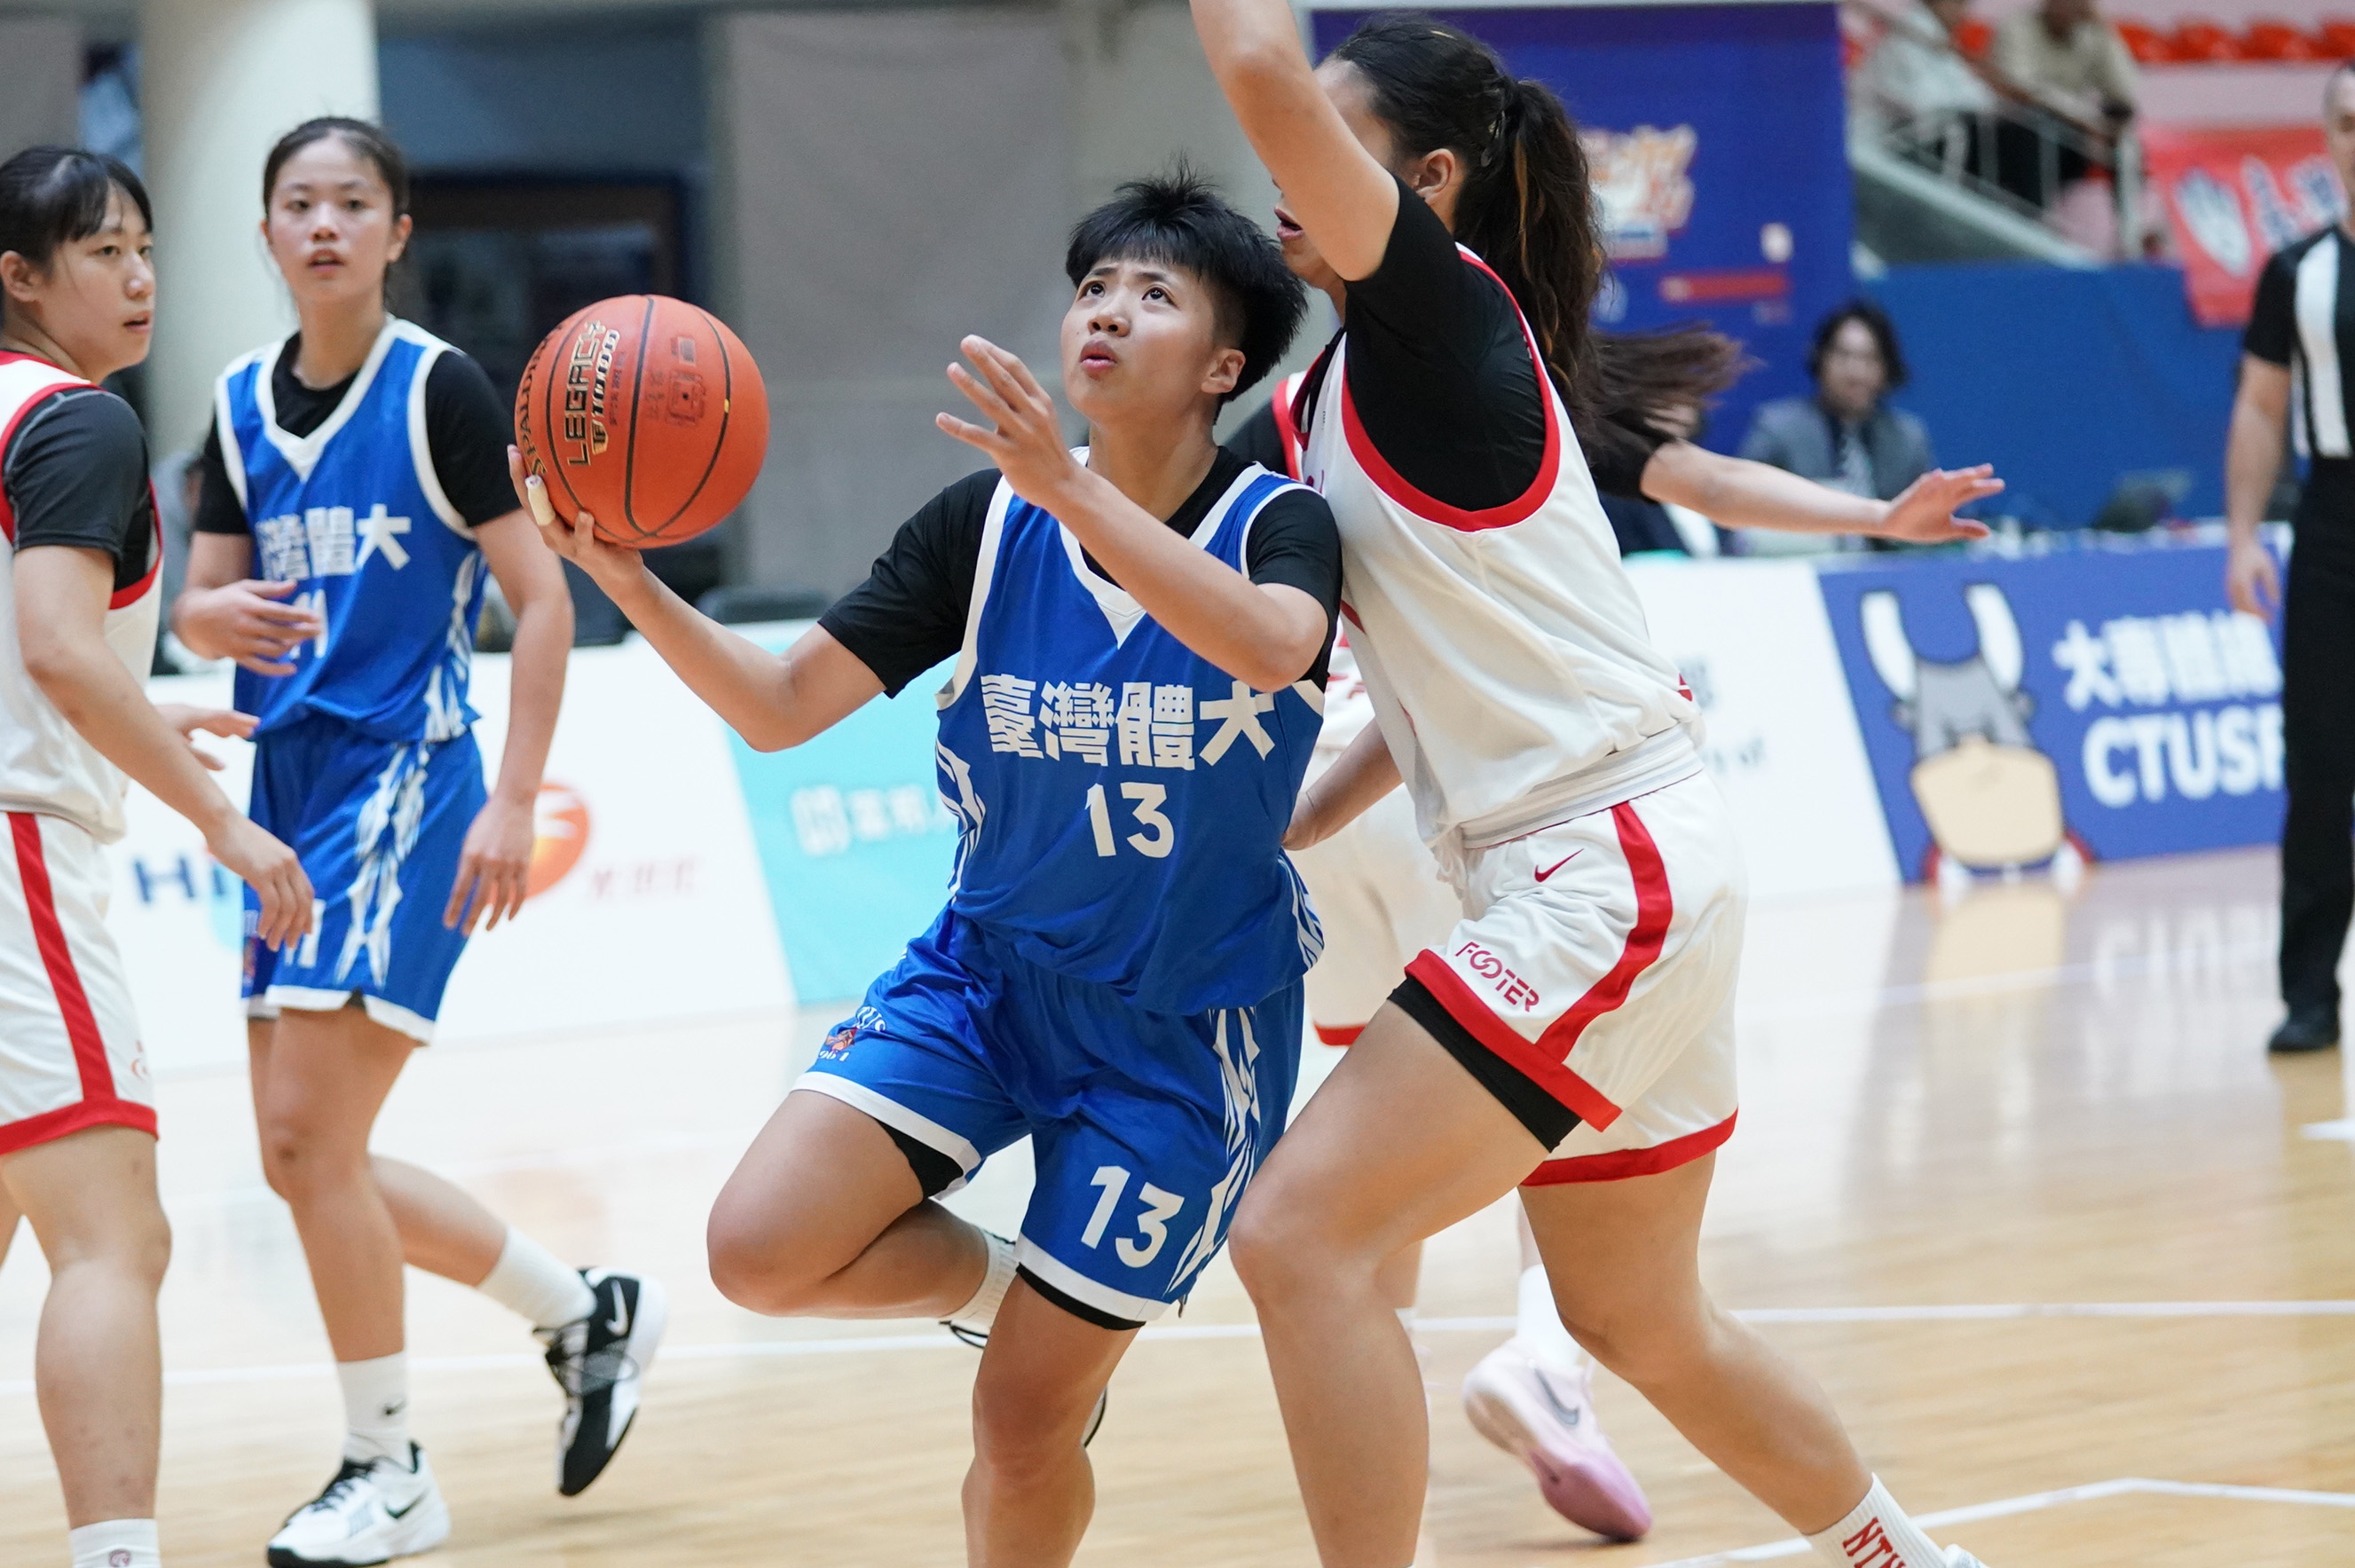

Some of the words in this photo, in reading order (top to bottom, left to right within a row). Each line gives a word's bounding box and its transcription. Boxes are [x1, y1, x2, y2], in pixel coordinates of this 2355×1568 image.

[563, 320, 607, 466] LEGACY
[981, 674, 1276, 771] 臺灣體大
[1084, 781, 1175, 858] 13
[1455, 942, 1540, 1013] FOOTER
[1081, 1165, 1185, 1269] 13
